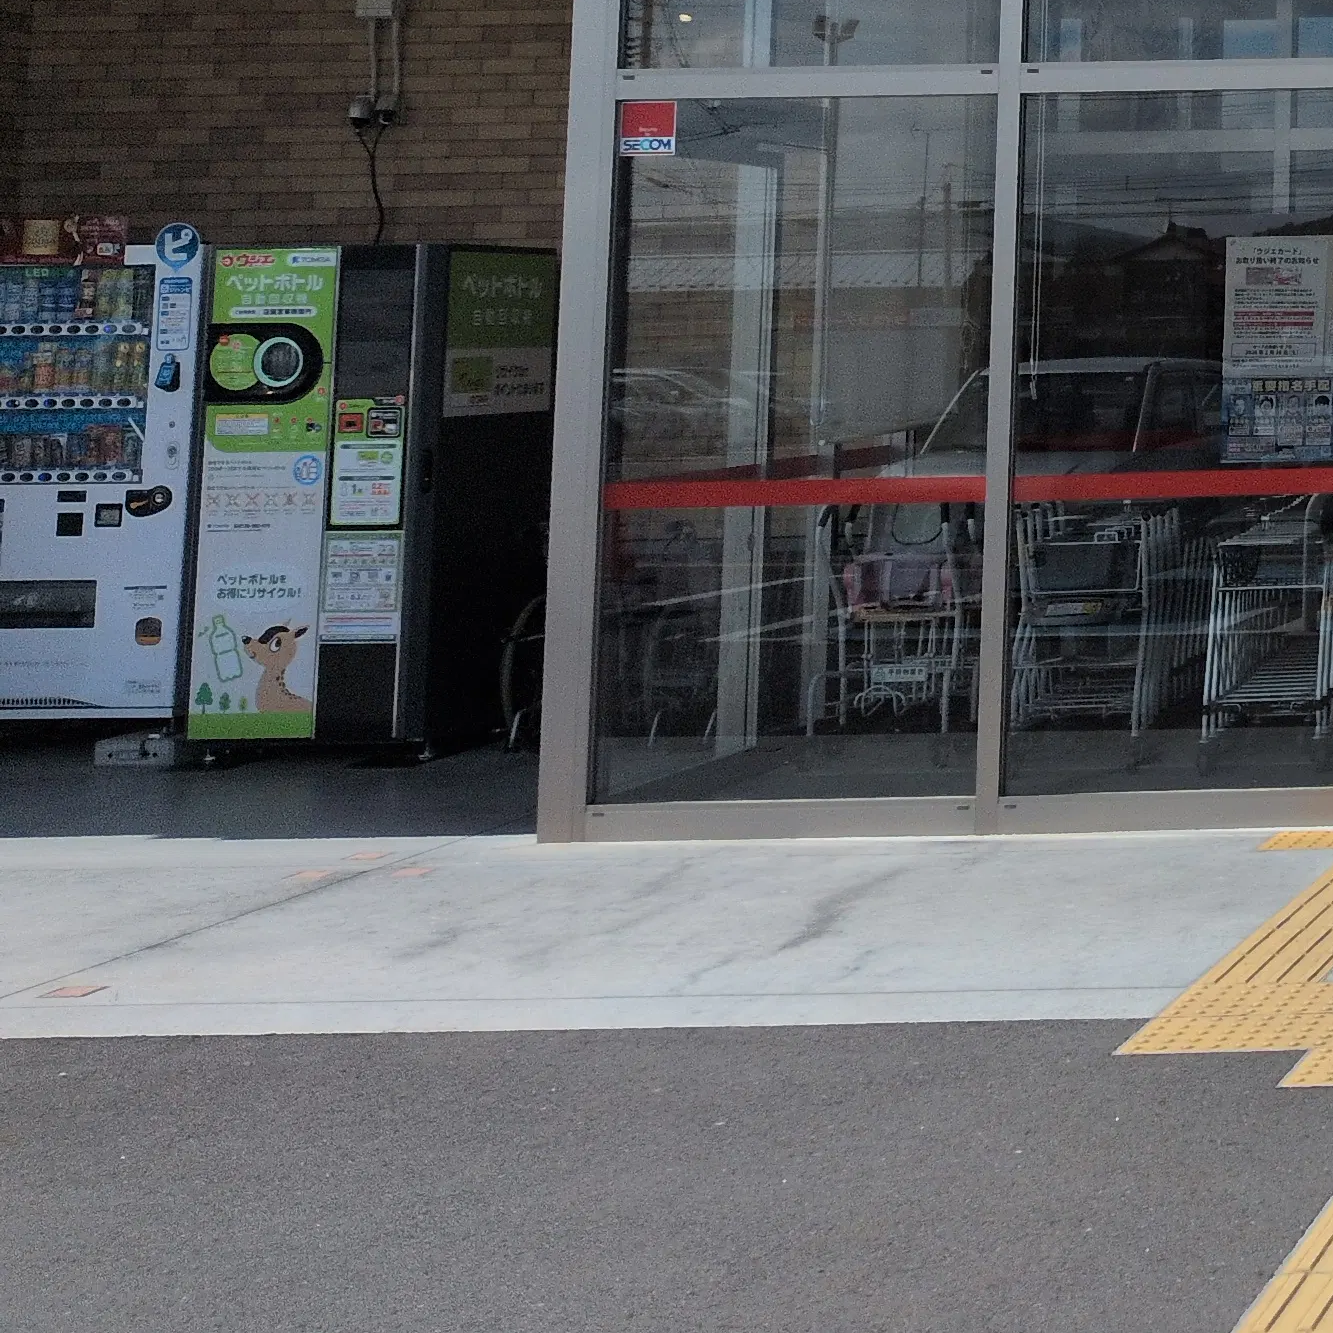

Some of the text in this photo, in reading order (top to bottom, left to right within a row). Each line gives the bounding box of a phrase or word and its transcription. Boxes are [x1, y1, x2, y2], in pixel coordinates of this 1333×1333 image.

[623, 138, 671, 151] SECOM
[164, 228, 193, 261] ピ
[226, 273, 325, 291] ペットボトル
